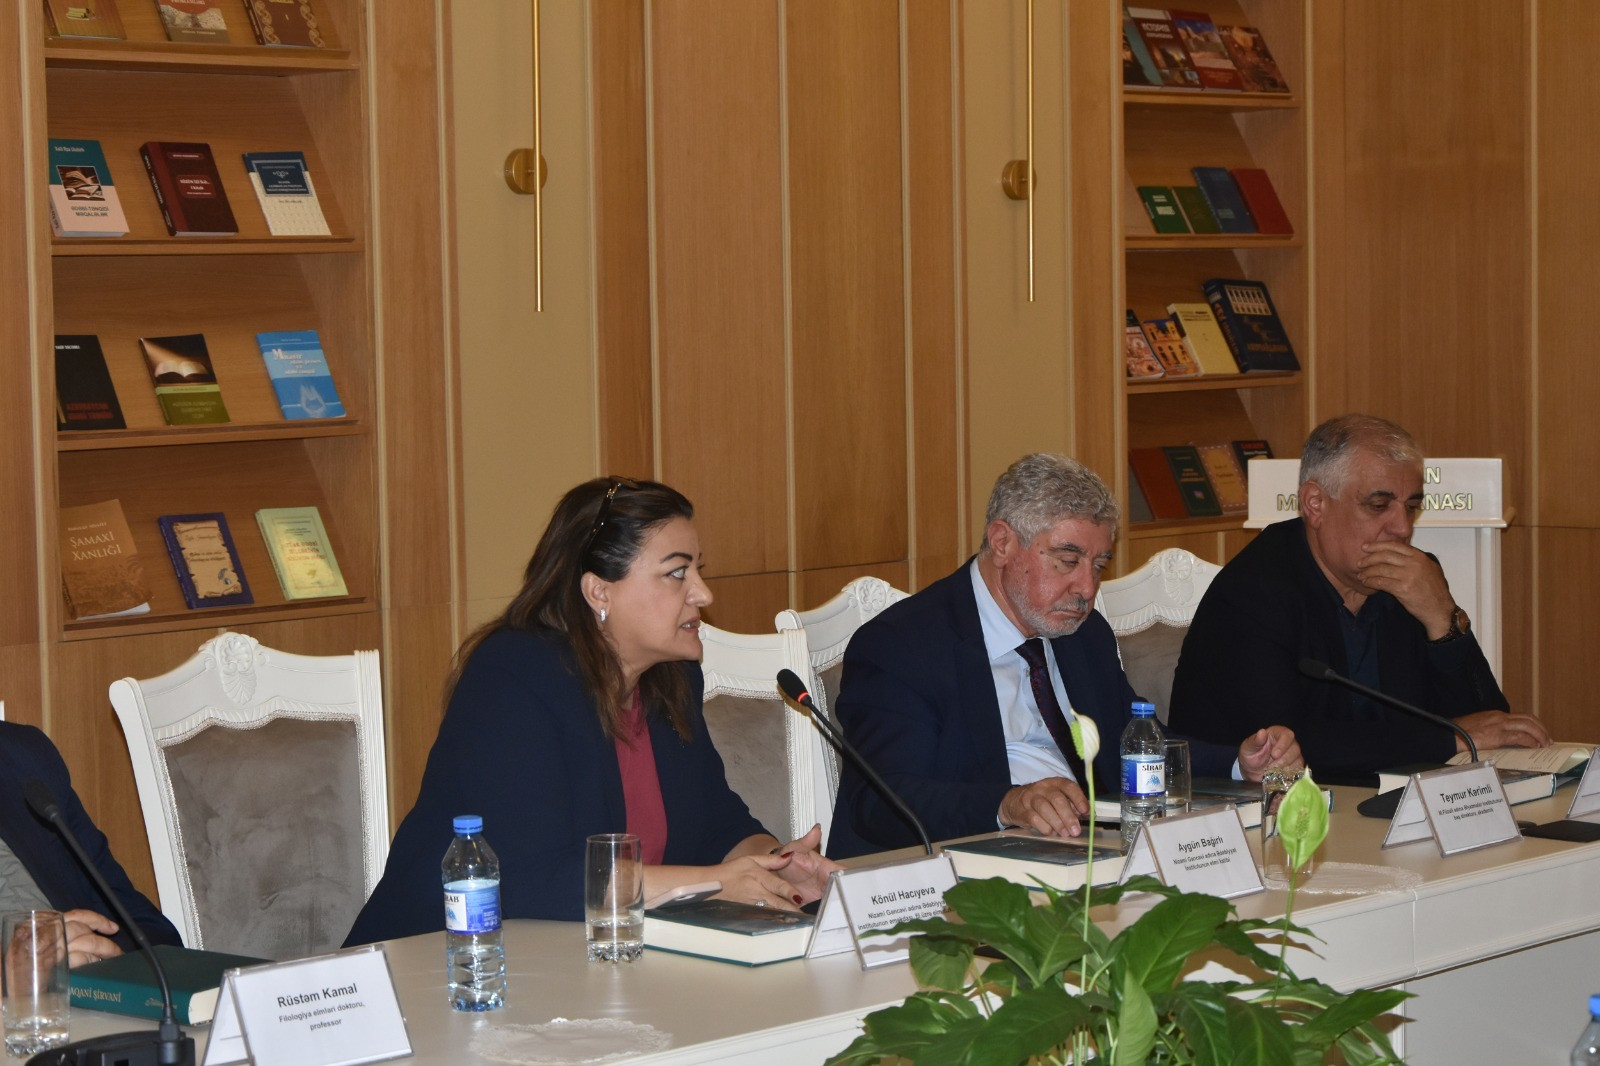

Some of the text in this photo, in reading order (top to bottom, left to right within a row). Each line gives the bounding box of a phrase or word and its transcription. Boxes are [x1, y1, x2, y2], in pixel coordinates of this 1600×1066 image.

[1423, 467, 1441, 484] N
[1277, 493, 1300, 511] M
[1440, 785, 1492, 804] Teymur Kərimli
[1178, 836, 1224, 853] Aygün Bağırlı
[871, 887, 936, 905] Könül Hacıyeva
[868, 911, 885, 919] Nizami
[922, 900, 946, 910] Ədəbiyya
[69, 985, 122, 1003] AQANİ ŞİRVANİ
[277, 983, 359, 1008] Rüstəm Kamal
[278, 1001, 366, 1023] Filologiya elmləri doktoru,
[310, 1018, 343, 1032] professor
